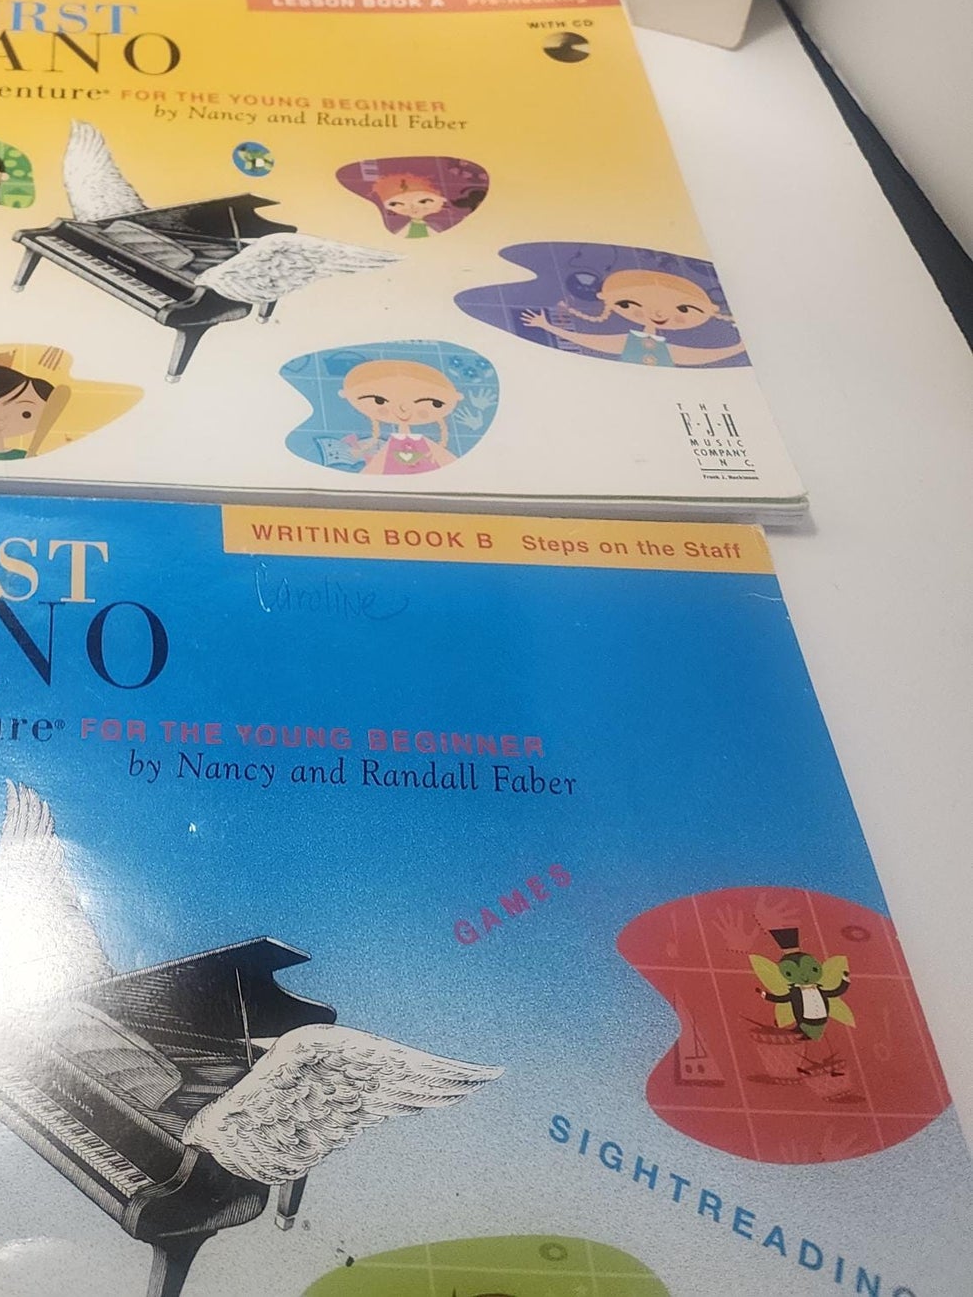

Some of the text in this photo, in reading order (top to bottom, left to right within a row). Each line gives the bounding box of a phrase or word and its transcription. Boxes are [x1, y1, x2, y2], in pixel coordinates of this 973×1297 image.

[528, 19, 593, 29] WITH CD
[121, 89, 167, 102] FOR
[176, 91, 220, 104] THE
[228, 93, 311, 109] YOUNG
[321, 98, 446, 113] BEGINNER
[154, 104, 468, 130] by Nancy and Randall Faber
[690, 439, 743, 447] MUSIC
[694, 449, 747, 457] COMPANY
[251, 523, 742, 559] WRITING BOOK B Steps on the Staff
[80, 718, 146, 742] FOR
[160, 720, 223, 745] THE
[237, 724, 352, 750] YOUNG
[368, 729, 544, 758] BEGINNER
[128, 749, 577, 795] by Nancy and Randall Faber
[452, 863, 573, 946] GAMES
[548, 1115, 917, 1297] SIGHTREADIN
